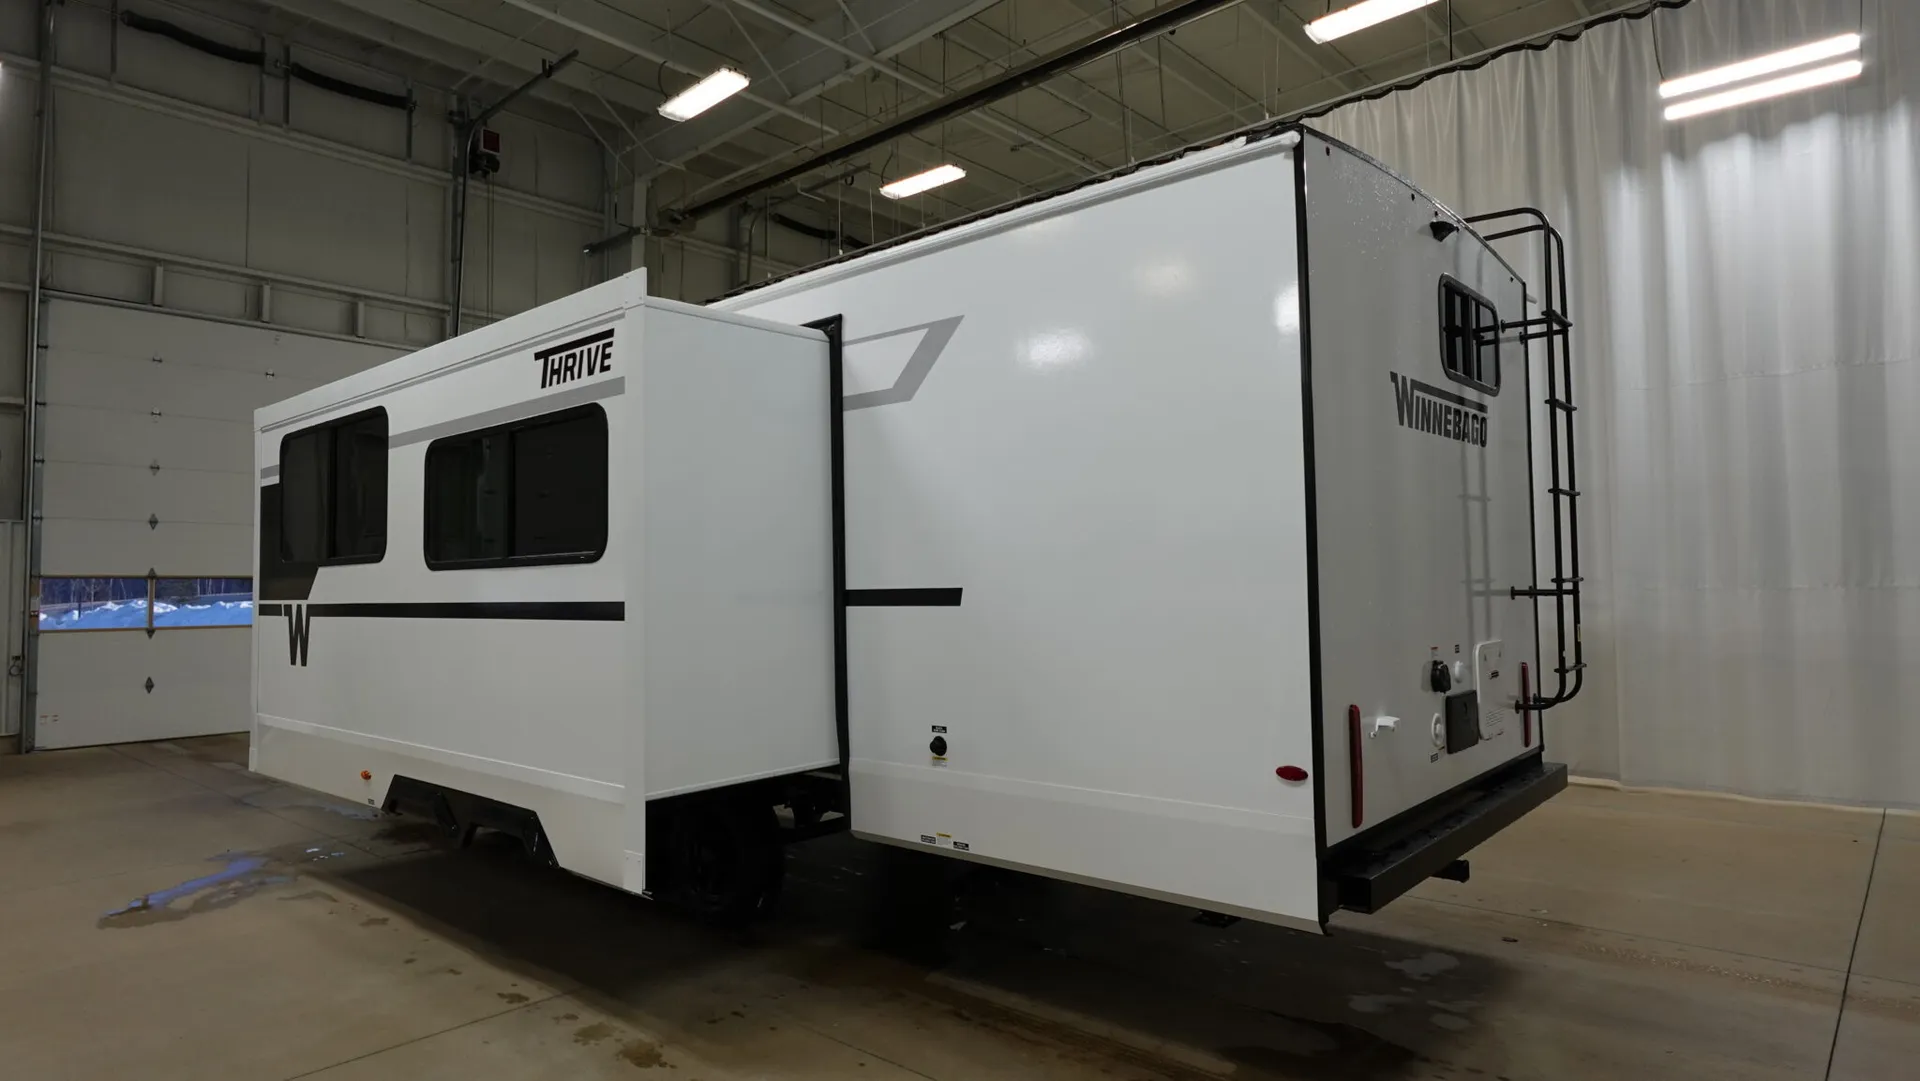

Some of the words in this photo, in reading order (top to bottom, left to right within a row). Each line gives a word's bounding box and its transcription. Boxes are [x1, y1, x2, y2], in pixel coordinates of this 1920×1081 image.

[534, 328, 615, 389] THRIVE
[1390, 371, 1488, 447] WINNEBAGO
[284, 604, 310, 667] W
